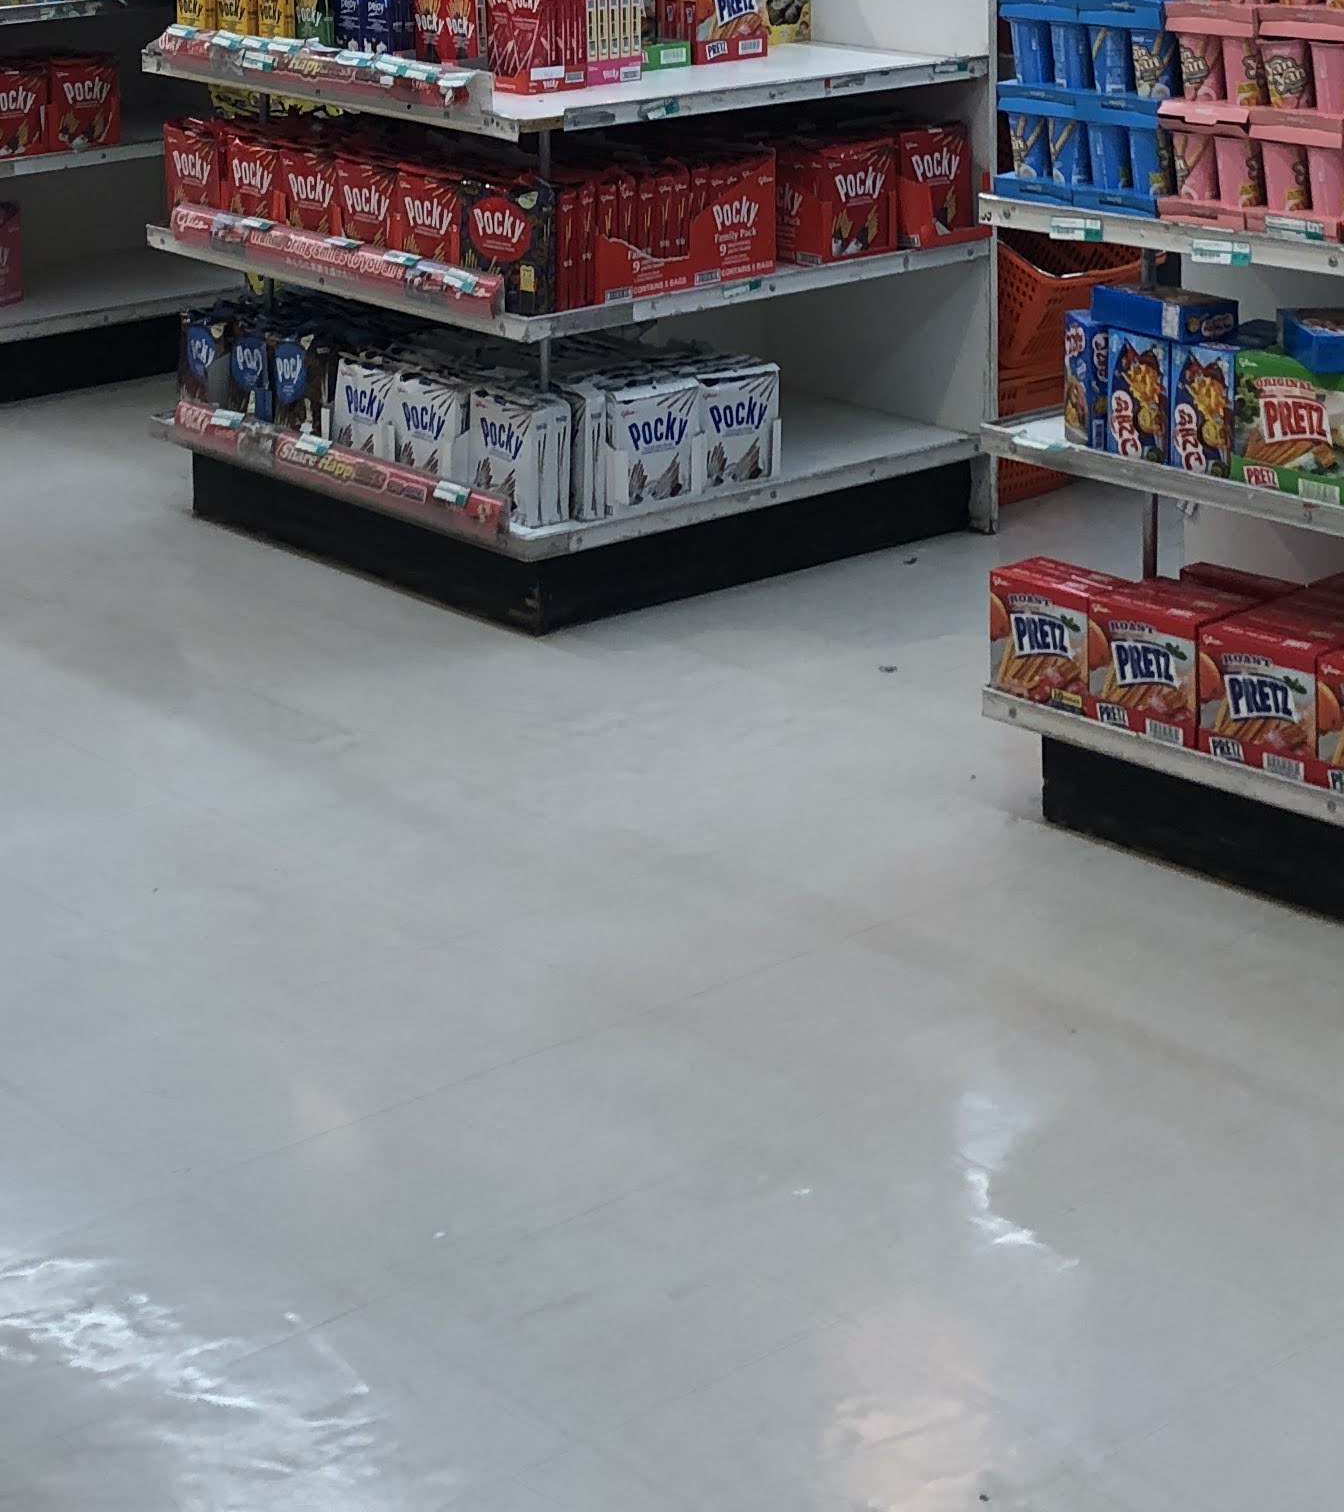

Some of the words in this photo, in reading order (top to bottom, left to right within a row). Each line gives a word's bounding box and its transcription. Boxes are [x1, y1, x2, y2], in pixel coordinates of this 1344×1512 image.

[367, 1, 386, 15] pejoy
[706, 42, 728, 57] PRETZ
[777, 187, 804, 216] cky
[714, 229, 737, 244] Family
[738, 227, 756, 238] Pack
[719, 243, 727, 257] 9
[632, 261, 640, 273] 9
[1253, 378, 1314, 393] ORIGINAL
[1264, 399, 1328, 439] PRETZ
[279, 444, 317, 467] Share
[1246, 467, 1277, 487] PRETZ
[1008, 595, 1052, 608] ROAST
[1014, 614, 1068, 654] PRETZ
[1108, 621, 1155, 634] ROAST
[1116, 643, 1174, 683] PRETZ
[1222, 655, 1271, 667] ROAST
[1229, 676, 1294, 716] PRETZ
[1099, 705, 1128, 725] PRETZ
[1211, 737, 1243, 758] PRETZ
